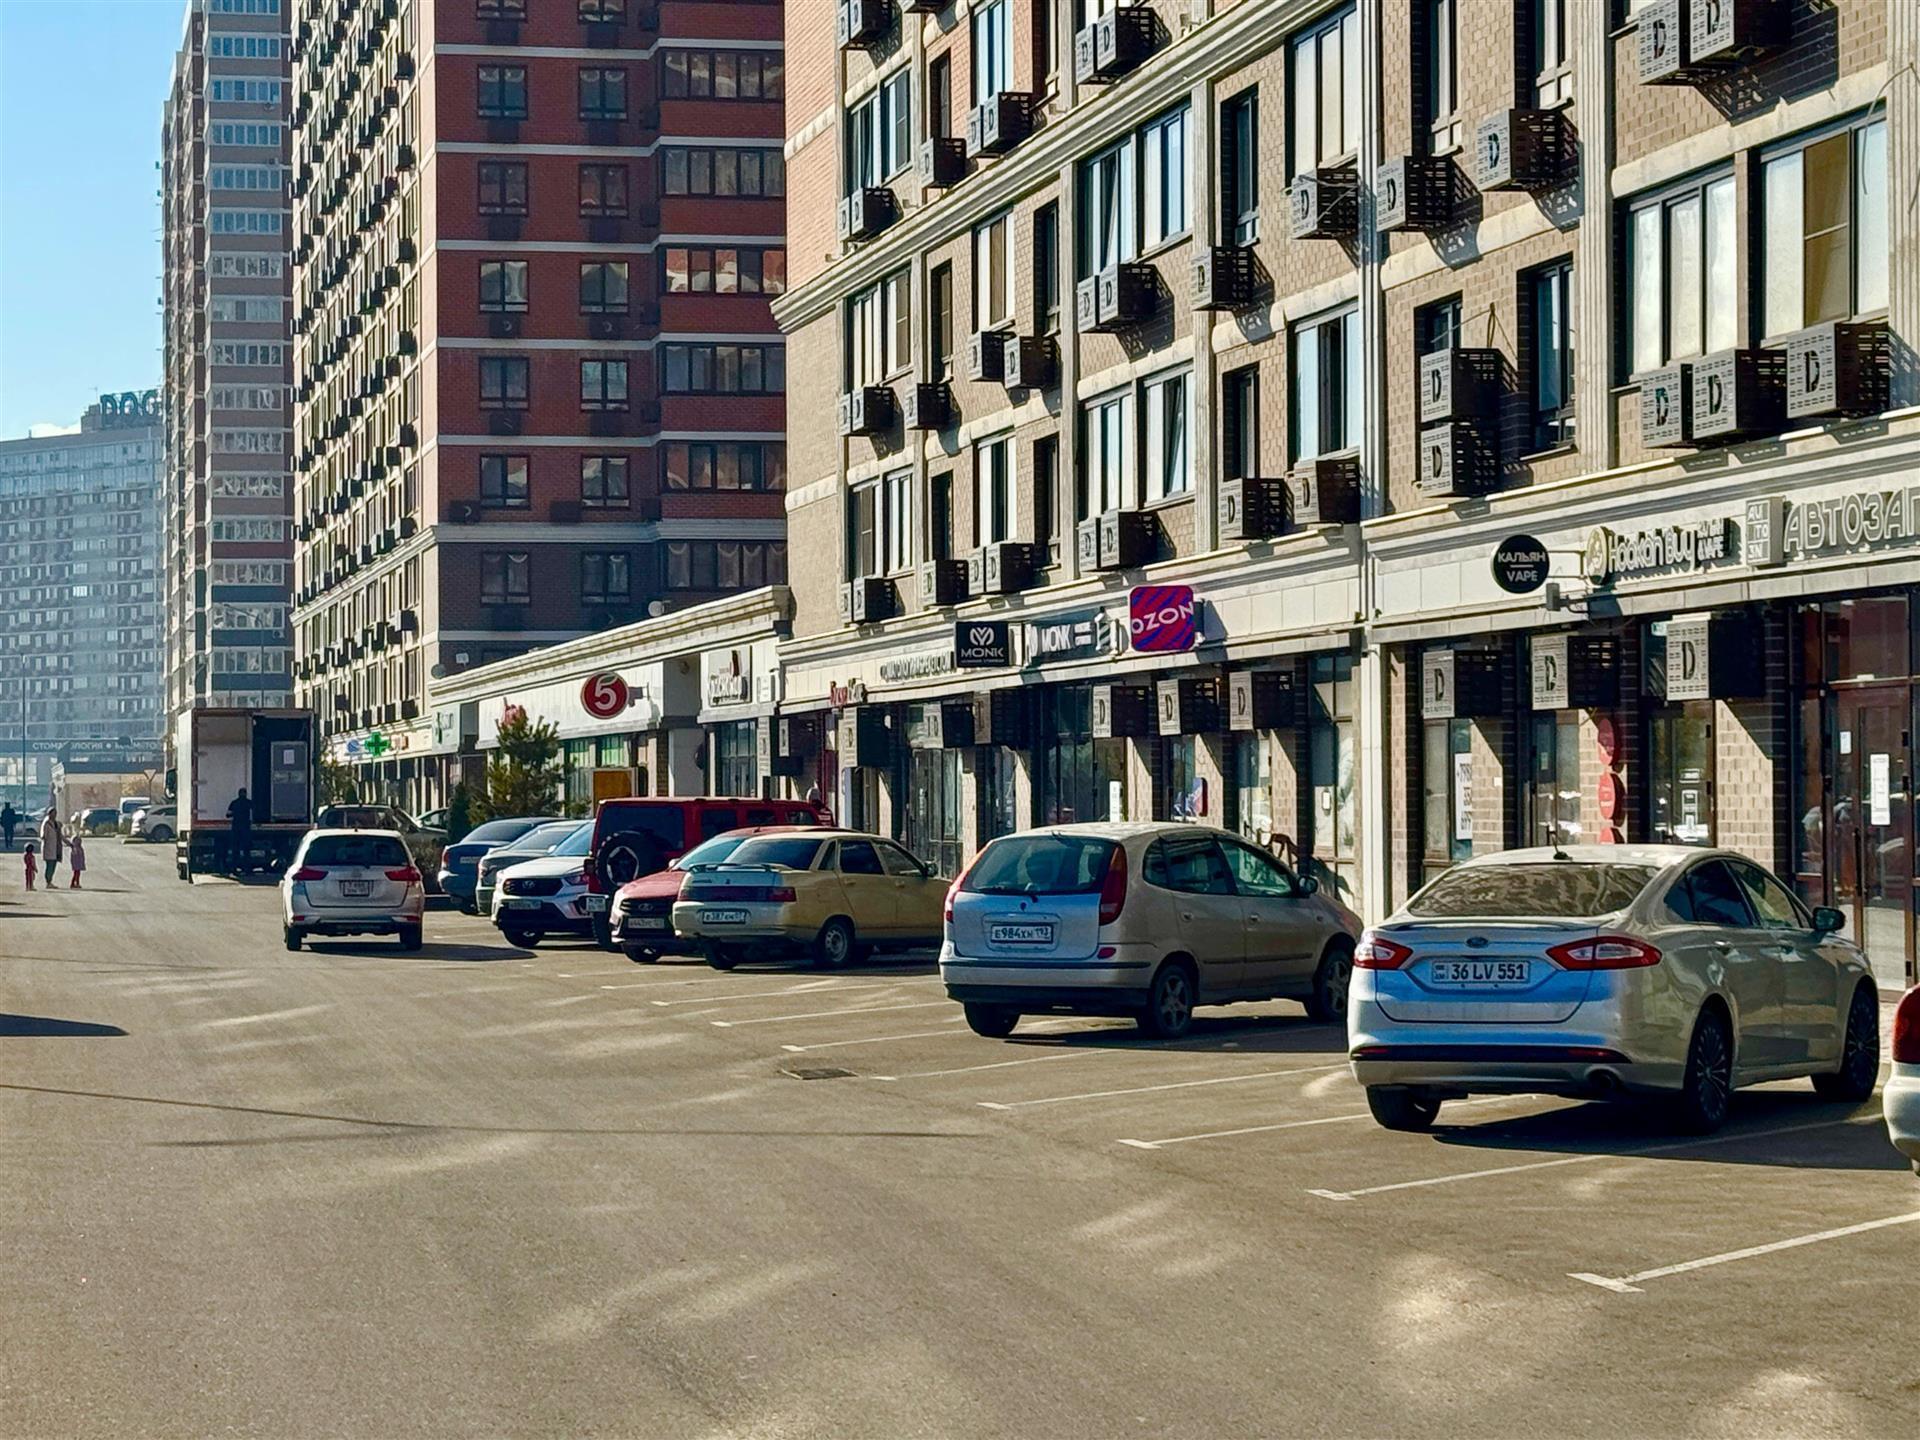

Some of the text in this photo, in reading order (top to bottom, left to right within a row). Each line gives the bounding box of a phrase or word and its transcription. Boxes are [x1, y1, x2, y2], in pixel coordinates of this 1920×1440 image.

[1498, 551, 1547, 563] КАЛЬЯН
[1506, 570, 1539, 582] VAPE
[1131, 601, 1193, 634] OZON
[961, 647, 1004, 658] MONK
[594, 674, 618, 711] 5
[1451, 963, 1525, 979] 36 LV 551
